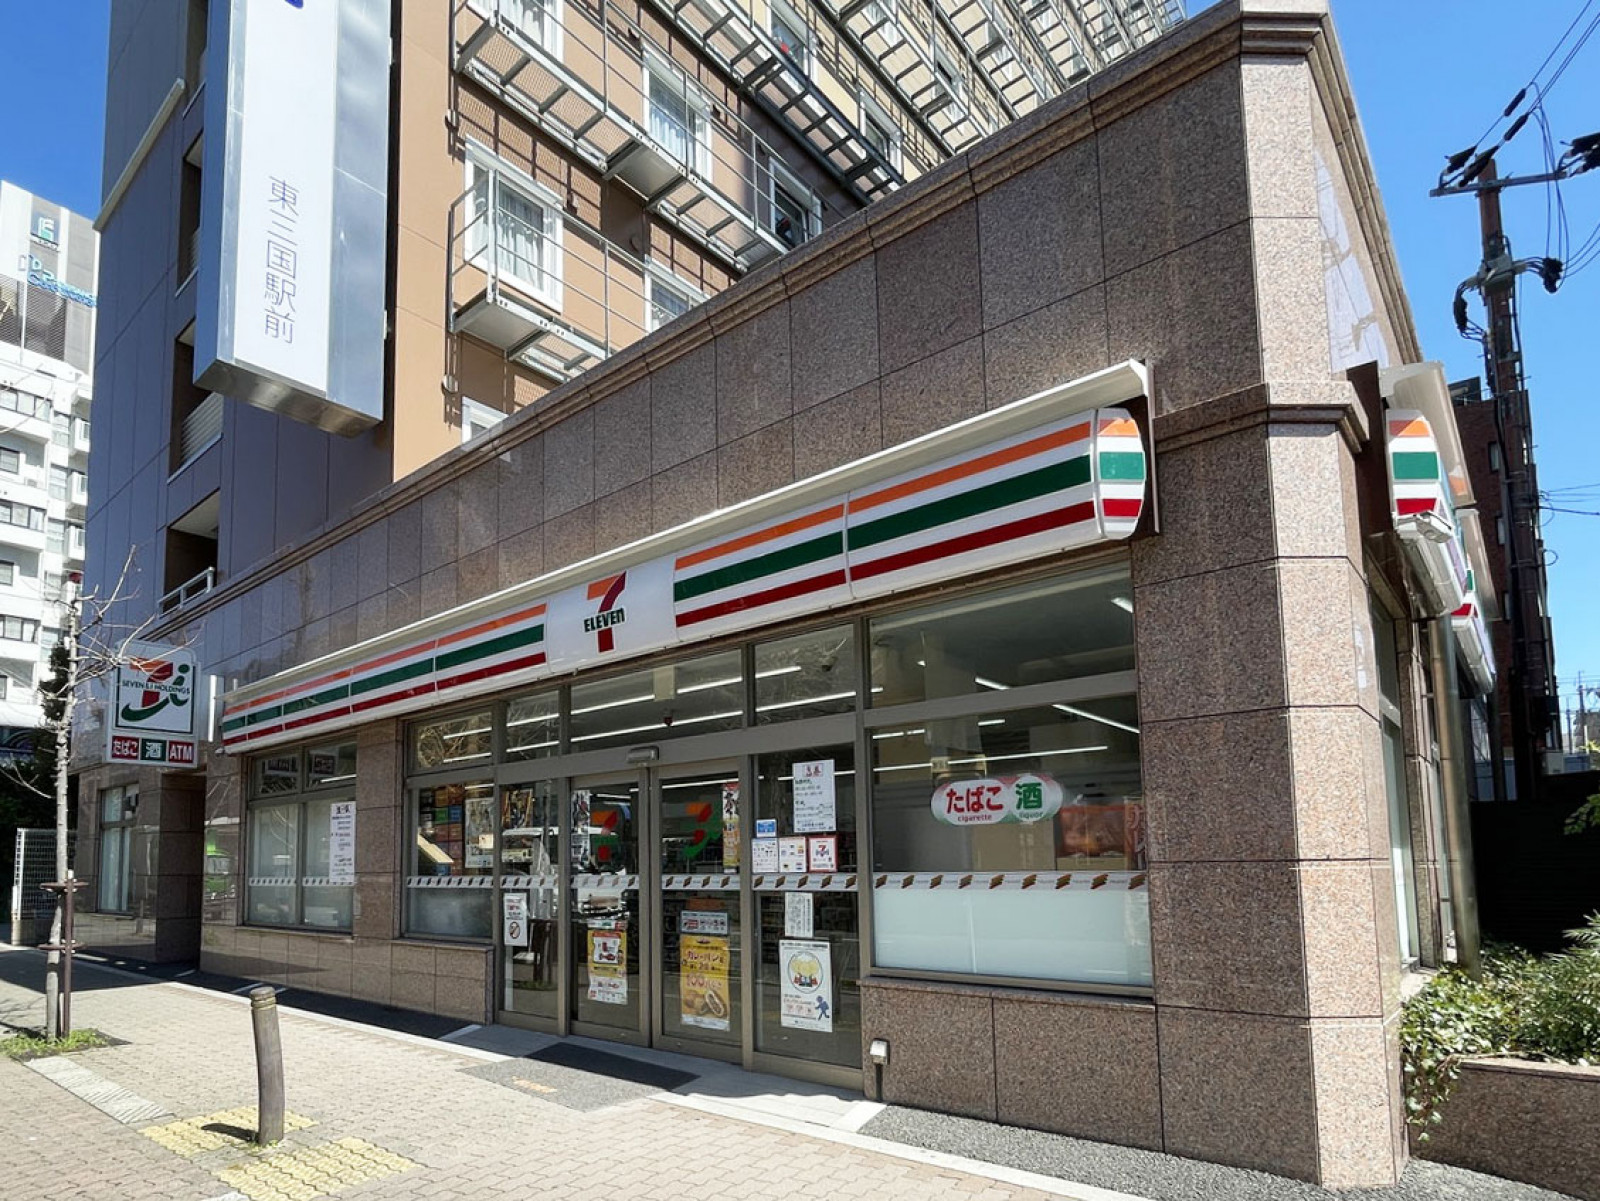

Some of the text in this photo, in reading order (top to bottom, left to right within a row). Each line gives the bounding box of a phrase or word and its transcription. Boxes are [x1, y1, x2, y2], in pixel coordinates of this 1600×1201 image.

[264, 176, 300, 344] 東三国駅前
[122, 680, 144, 689] SEVEN
[155, 684, 190, 694] HOLDINGS
[113, 741, 138, 756] たばこ
[145, 742, 163, 758] 酒
[169, 745, 193, 761] ATM
[946, 785, 1004, 814] たばこ
[1016, 782, 1042, 810] 酒
[957, 814, 992, 823] cigarette
[1020, 811, 1044, 820] liquor
